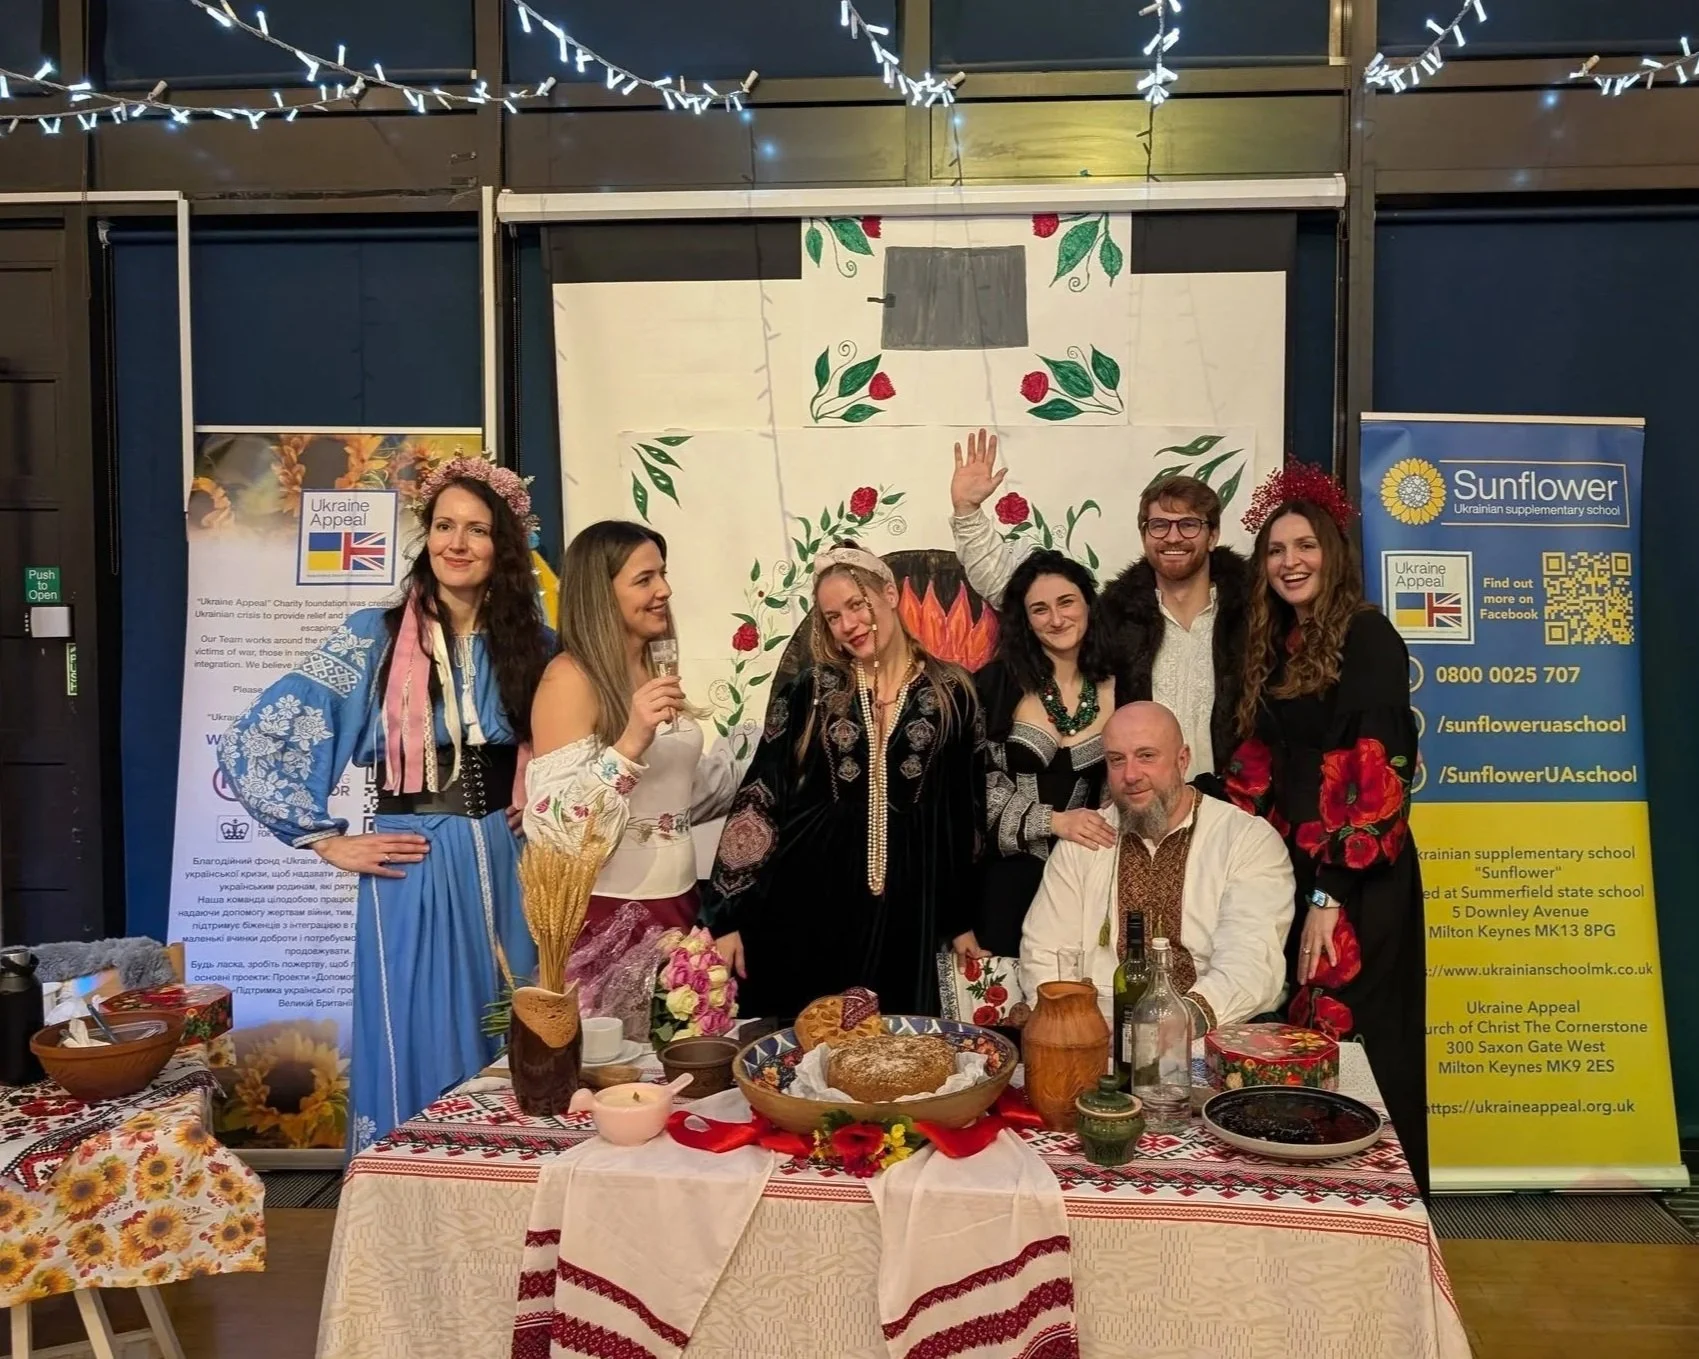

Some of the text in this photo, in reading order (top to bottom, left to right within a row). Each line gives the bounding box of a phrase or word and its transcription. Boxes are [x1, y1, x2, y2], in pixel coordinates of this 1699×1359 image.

[1453, 469, 1619, 502] Sunflower
[311, 498, 370, 512] Ukraine
[1454, 503, 1620, 517] Ukrainian supplementary school
[310, 513, 367, 530] Appeal
[1395, 561, 1446, 574] Ukraine
[28, 570, 56, 580] Push
[37, 581, 48, 590] to
[1395, 575, 1445, 589] Appeal
[1483, 578, 1533, 589] Find out
[28, 590, 58, 602] Open
[1483, 595, 1534, 604] more on
[237, 611, 261, 619] crisis
[274, 612, 305, 620] provide
[1480, 609, 1539, 620] Facebook
[201, 635, 216, 643] Our
[259, 649, 283, 657] those
[1436, 667, 1581, 684] 0800 0025 707
[1437, 715, 1627, 734] /sunfloweruaschool
[1439, 765, 1637, 784] /SunflowerUAschool
[1417, 846, 1635, 864] krainian supplementary school
[193, 857, 252, 866] Благодійний
[254, 857, 280, 866] фонд
[185, 870, 240, 879] української
[271, 870, 292, 878] щоб
[1475, 865, 1563, 880] "Sunflower"
[219, 883, 274, 892] українським
[1423, 884, 1645, 899] ed at Summerfield state school
[267, 896, 319, 904] цілодобово
[1452, 905, 1589, 922] 5 Downley Avenue
[192, 921, 240, 930] підтримує
[242, 922, 280, 930] біженців
[289, 922, 341, 930] інтеграцією
[260, 934, 298, 943] доброти
[1428, 925, 1616, 941] Milton Keynes MK13 8PG
[190, 960, 215, 969] Будь
[247, 960, 280, 969] зробіть
[330, 960, 350, 968] щоб
[272, 973, 310, 981] Проекти
[283, 986, 336, 995] української
[278, 999, 314, 1007] Великій
[1466, 1001, 1581, 1017] Ukraine Appeal
[1425, 1020, 1648, 1035] urch of Christ The Cornerstone
[1446, 1040, 1606, 1054] 300 Saxon Gate West
[1438, 1060, 1615, 1077] Milton Keynes MK9 2ES
